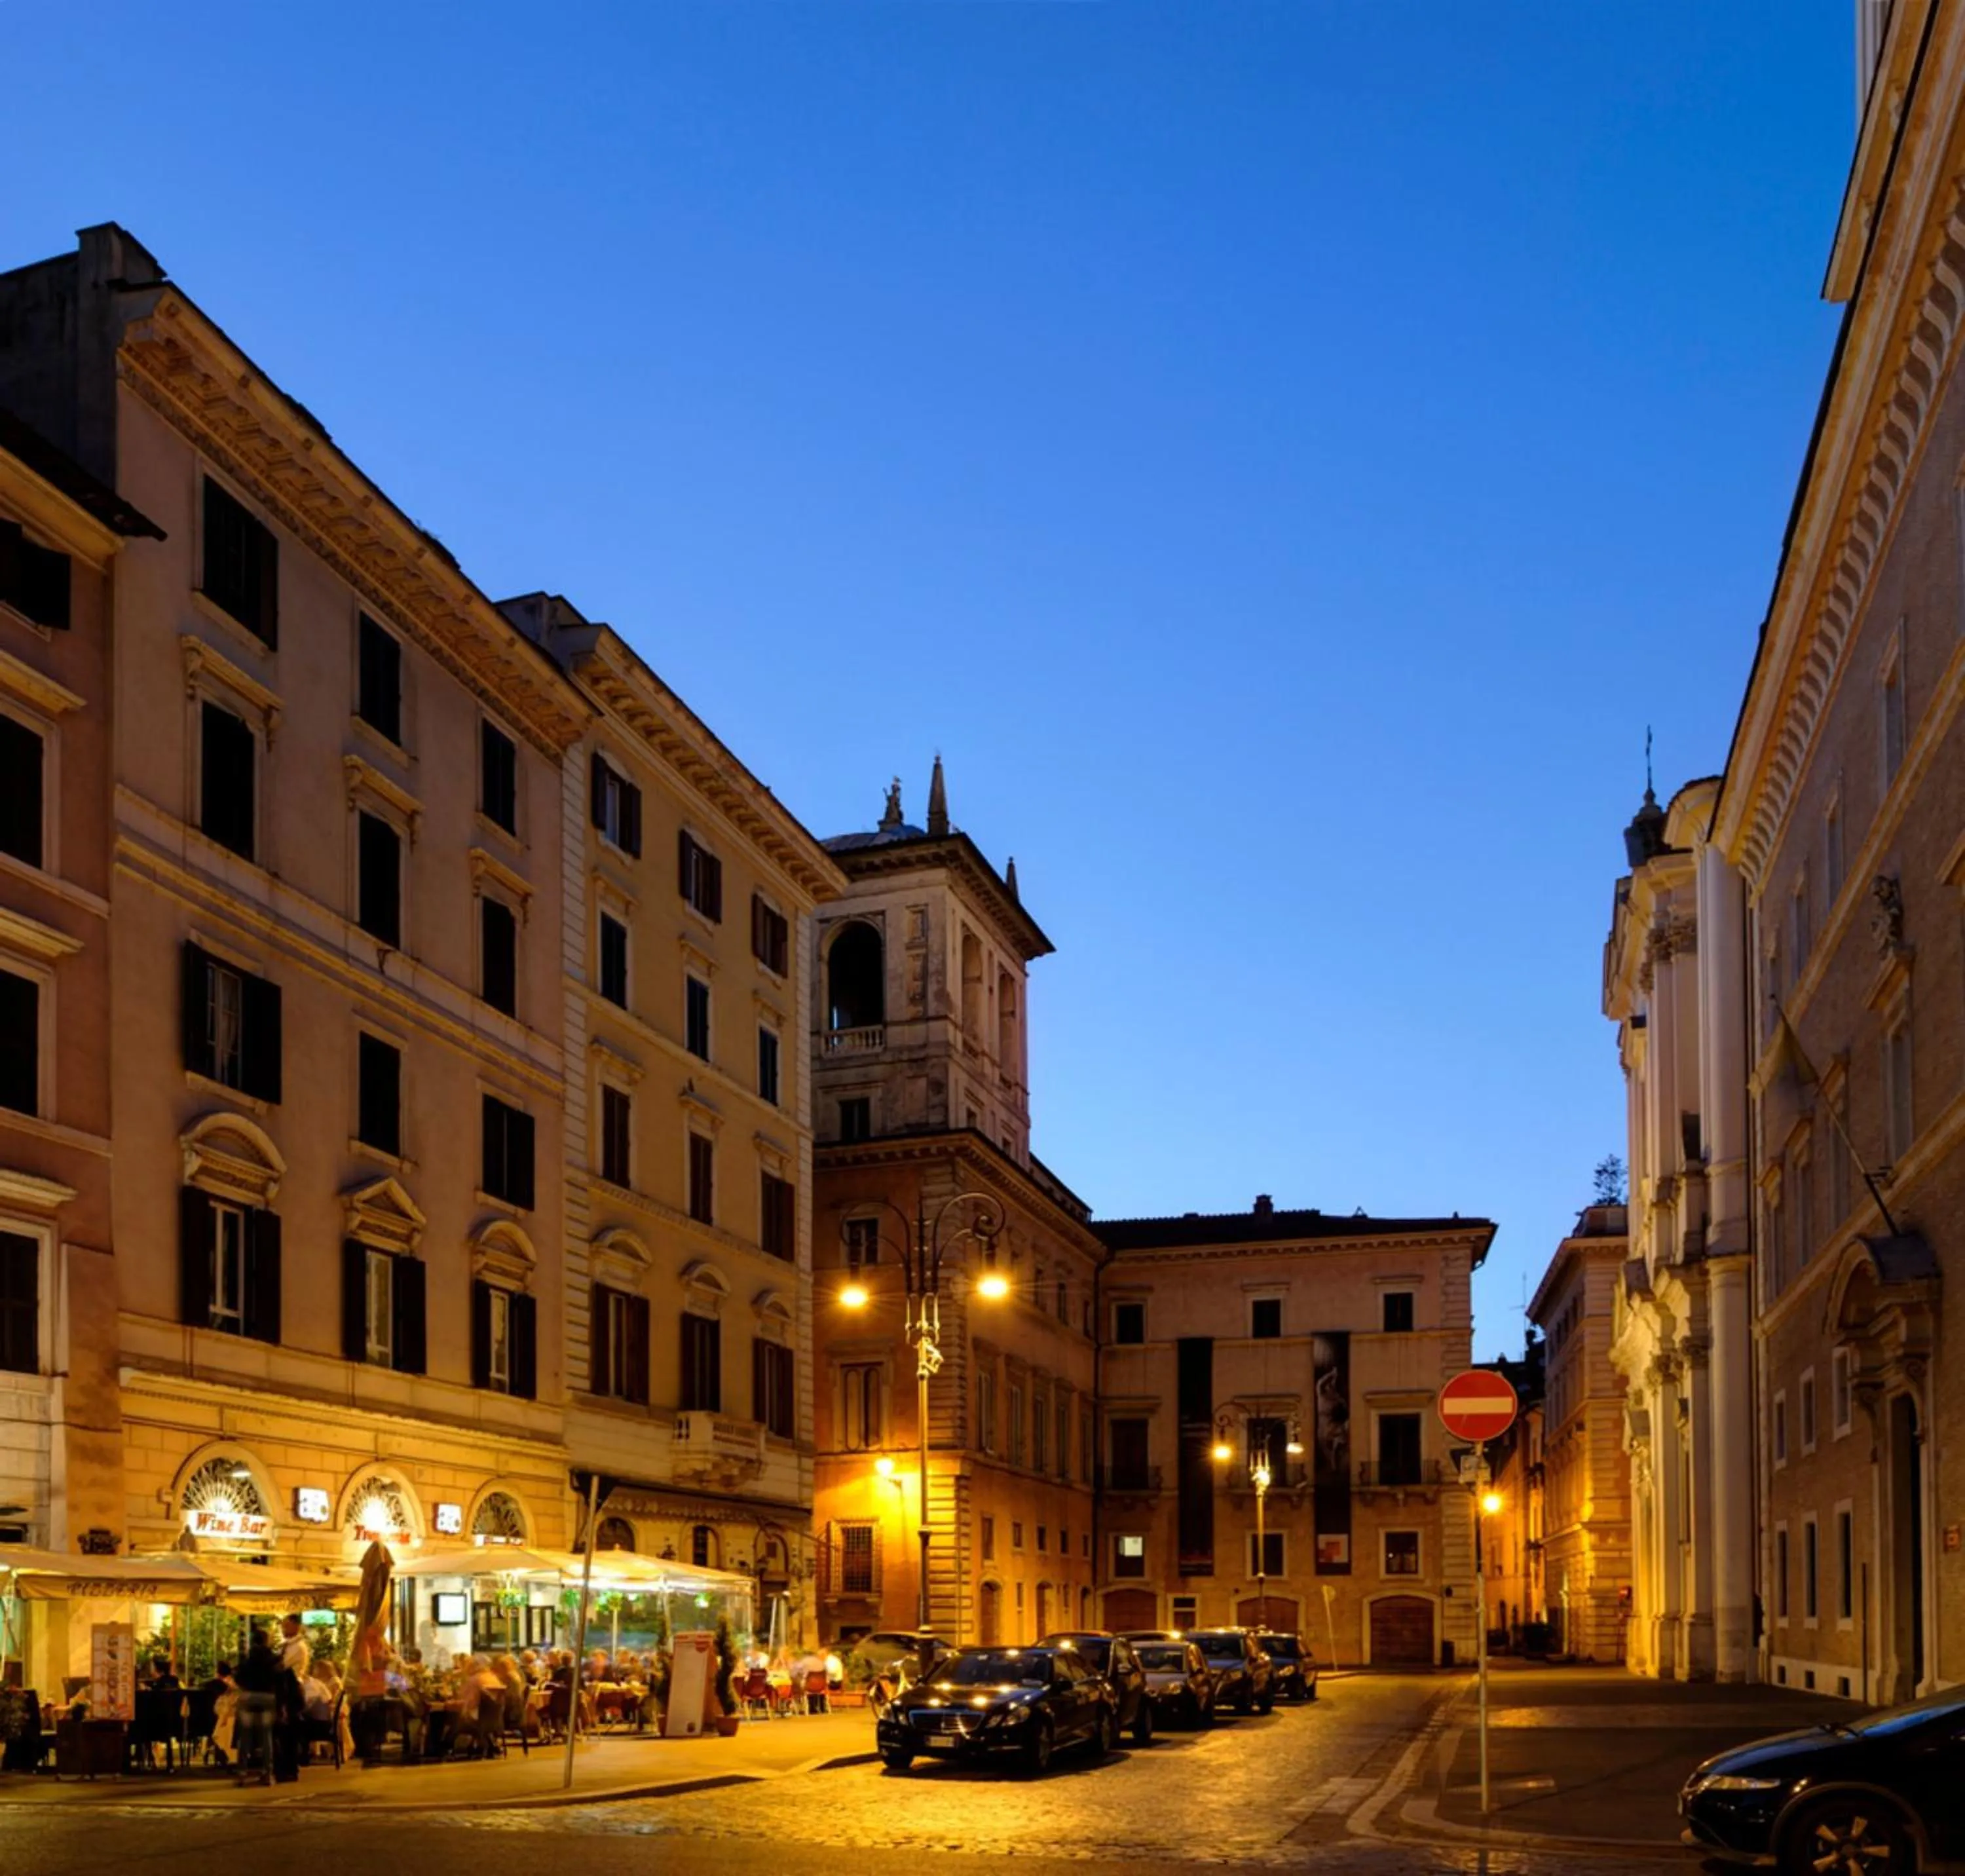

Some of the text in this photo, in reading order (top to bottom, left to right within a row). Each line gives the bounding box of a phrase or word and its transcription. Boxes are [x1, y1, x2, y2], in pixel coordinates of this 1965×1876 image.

[196, 1512, 267, 1533] Wine Bar
[67, 1581, 157, 1599] PIZZERIA
